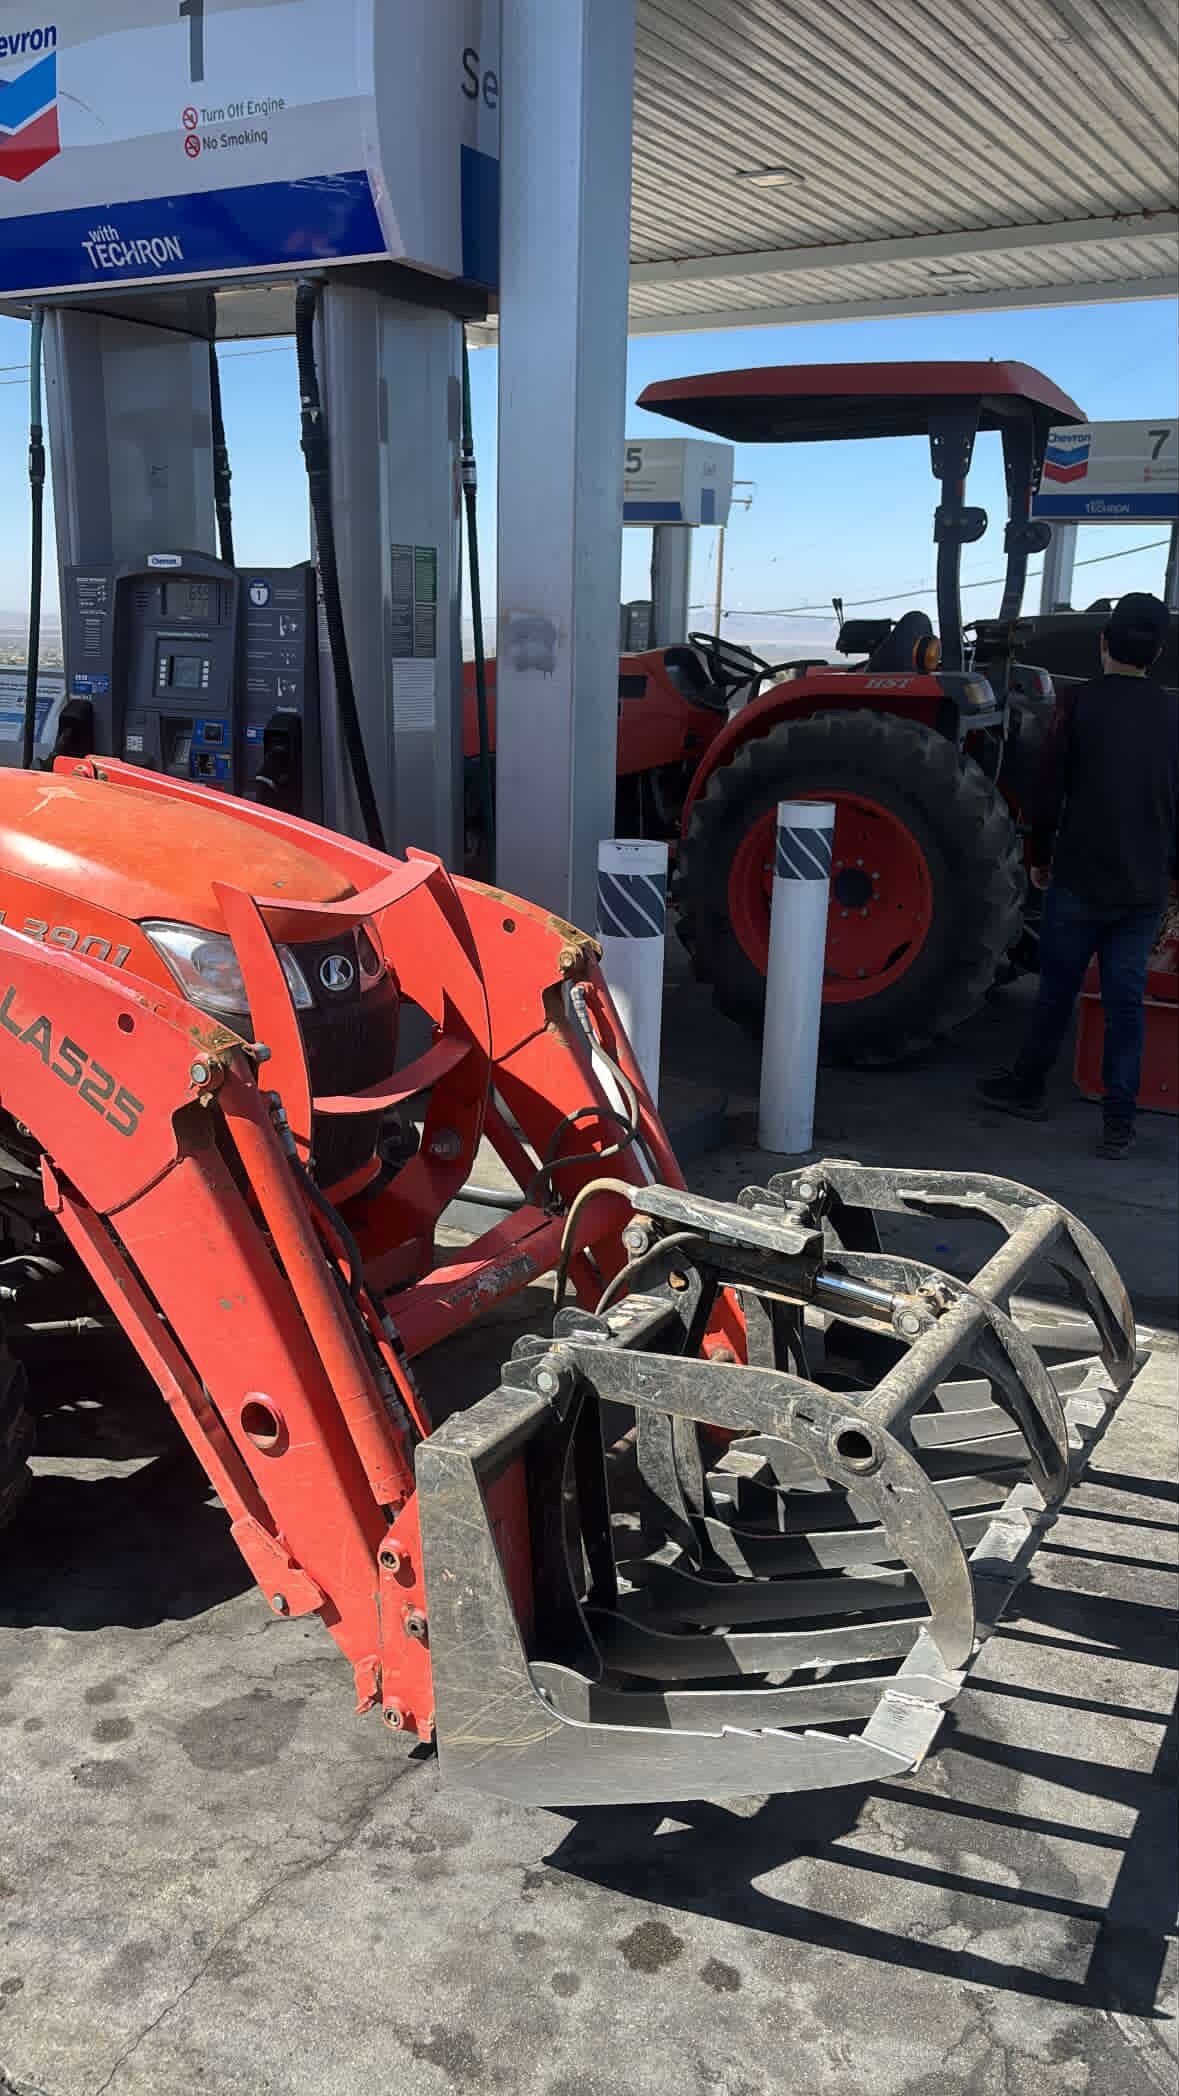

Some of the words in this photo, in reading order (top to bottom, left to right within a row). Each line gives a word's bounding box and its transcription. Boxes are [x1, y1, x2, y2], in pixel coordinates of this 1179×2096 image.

[200, 109, 225, 122] Turn
[227, 103, 244, 118] Off
[247, 98, 285, 116] Engine
[202, 137, 218, 150] No
[220, 129, 268, 148] Smoking
[88, 224, 120, 242] with
[81, 235, 184, 269] TECHRON
[1148, 429, 1171, 461] 7
[625, 447, 643, 474] 5
[0, 984, 145, 1137] LA525
